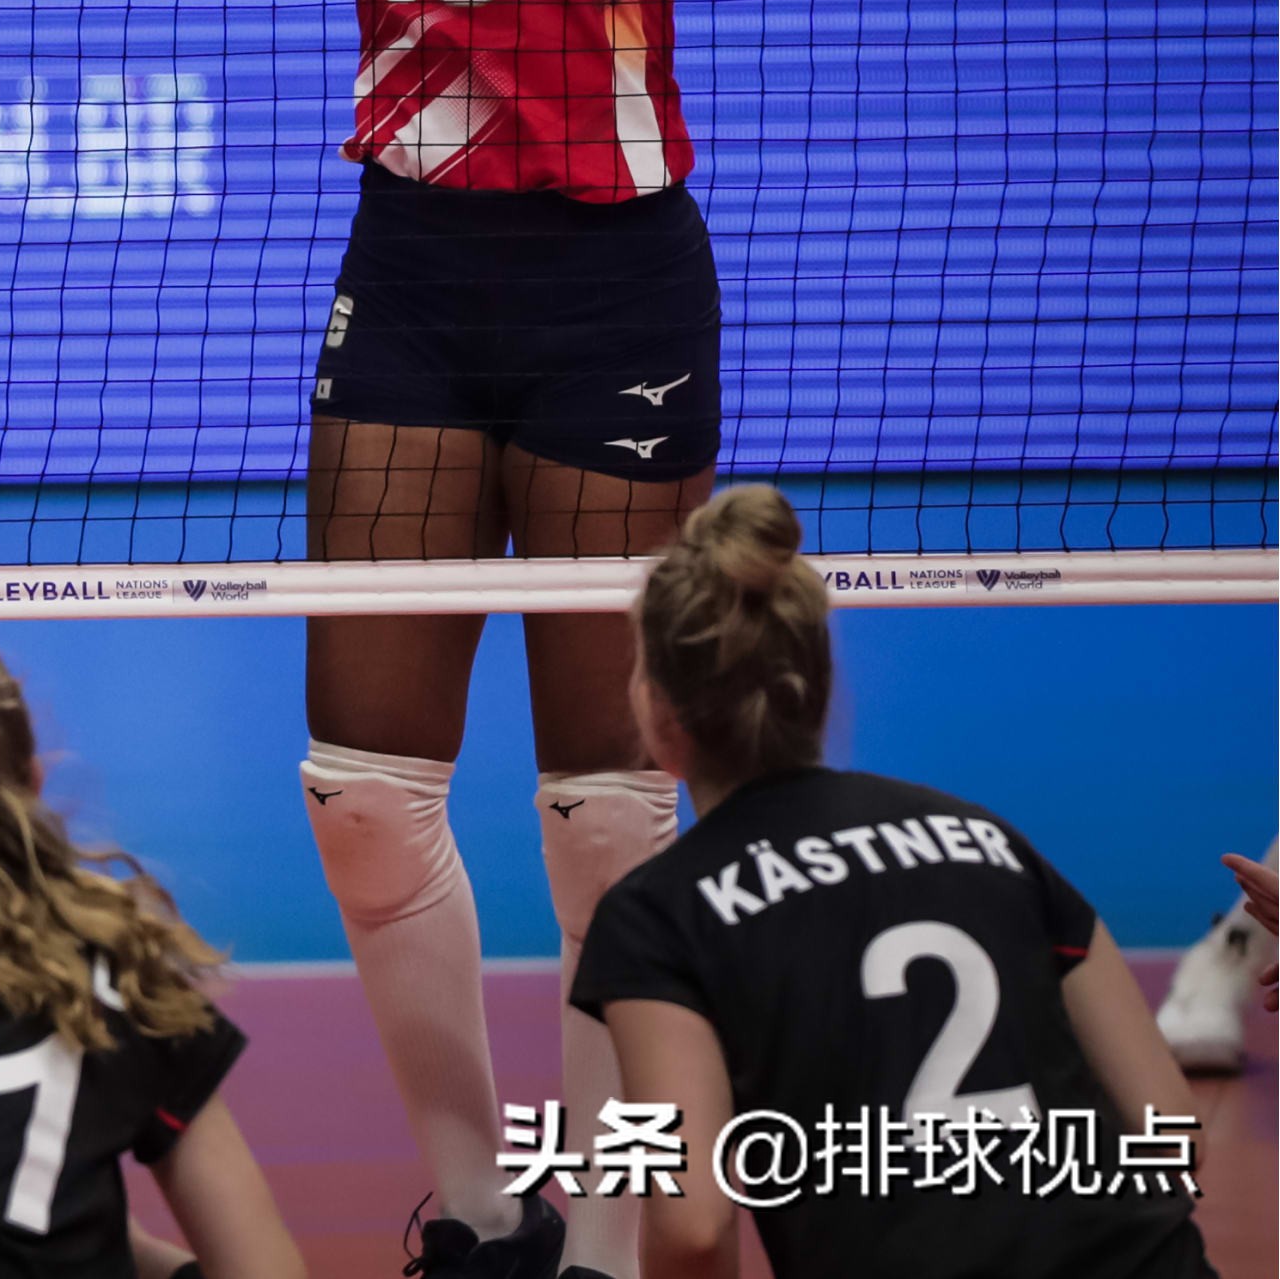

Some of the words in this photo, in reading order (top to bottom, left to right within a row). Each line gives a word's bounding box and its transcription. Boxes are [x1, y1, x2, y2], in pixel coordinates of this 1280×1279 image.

[909, 568, 963, 579] NATIONS
[1004, 569, 1062, 581] Volleyball
[115, 579, 169, 590] NATIONS
[210, 580, 268, 592] Volleyball
[909, 580, 958, 589] LEAGUE
[1004, 580, 1044, 591] World
[115, 590, 163, 599] LEAGUE
[210, 591, 250, 601] World
[696, 814, 1025, 926] KÄSTNER
[859, 920, 1039, 1147] 2
